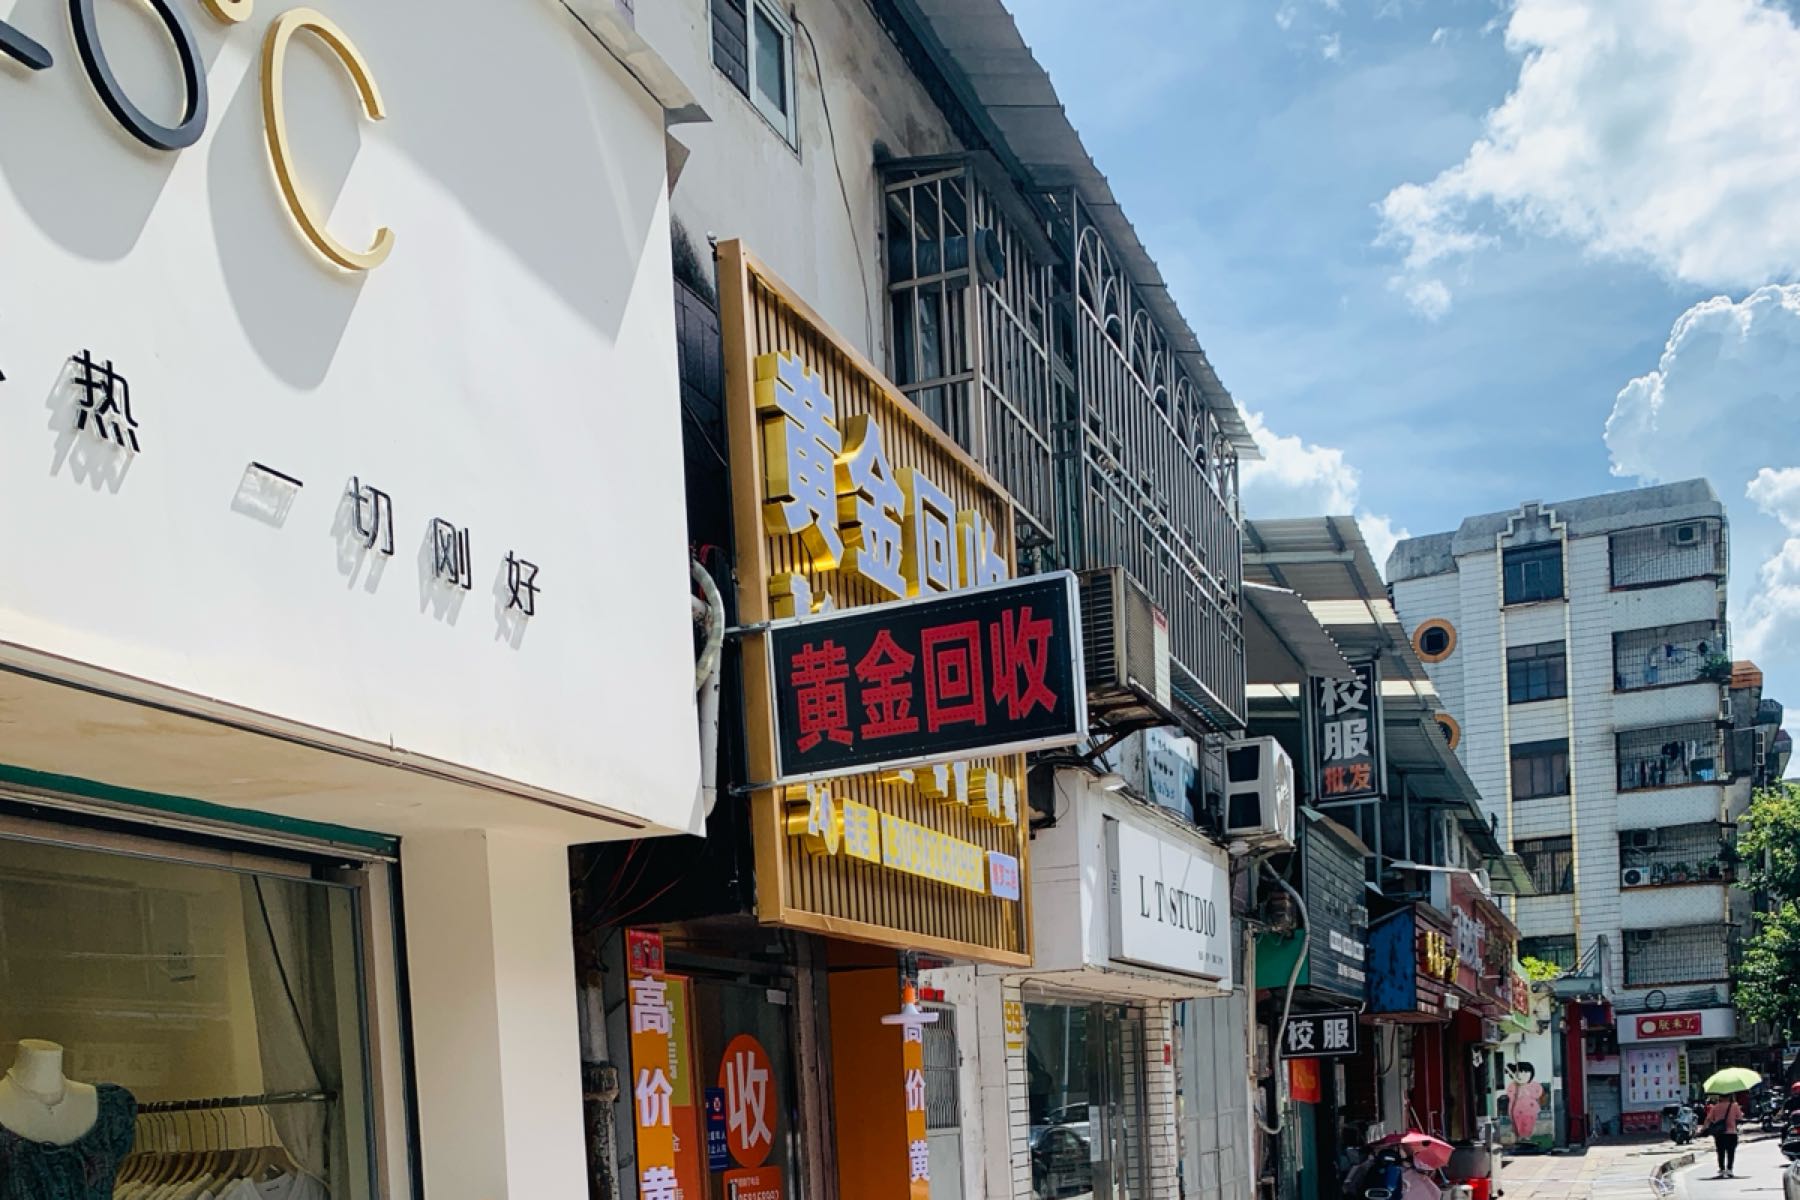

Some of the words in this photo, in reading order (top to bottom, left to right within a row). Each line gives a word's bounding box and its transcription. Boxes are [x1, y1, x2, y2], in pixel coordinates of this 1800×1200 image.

[252, 461, 541, 616] 一切刚好
[790, 606, 1057, 752] 黄金回收
[1325, 763, 1373, 794] 批发
[1169, 886, 1217, 938] STUDIO
[1287, 1018, 1351, 1051] 校服
[726, 1051, 771, 1149] 收
